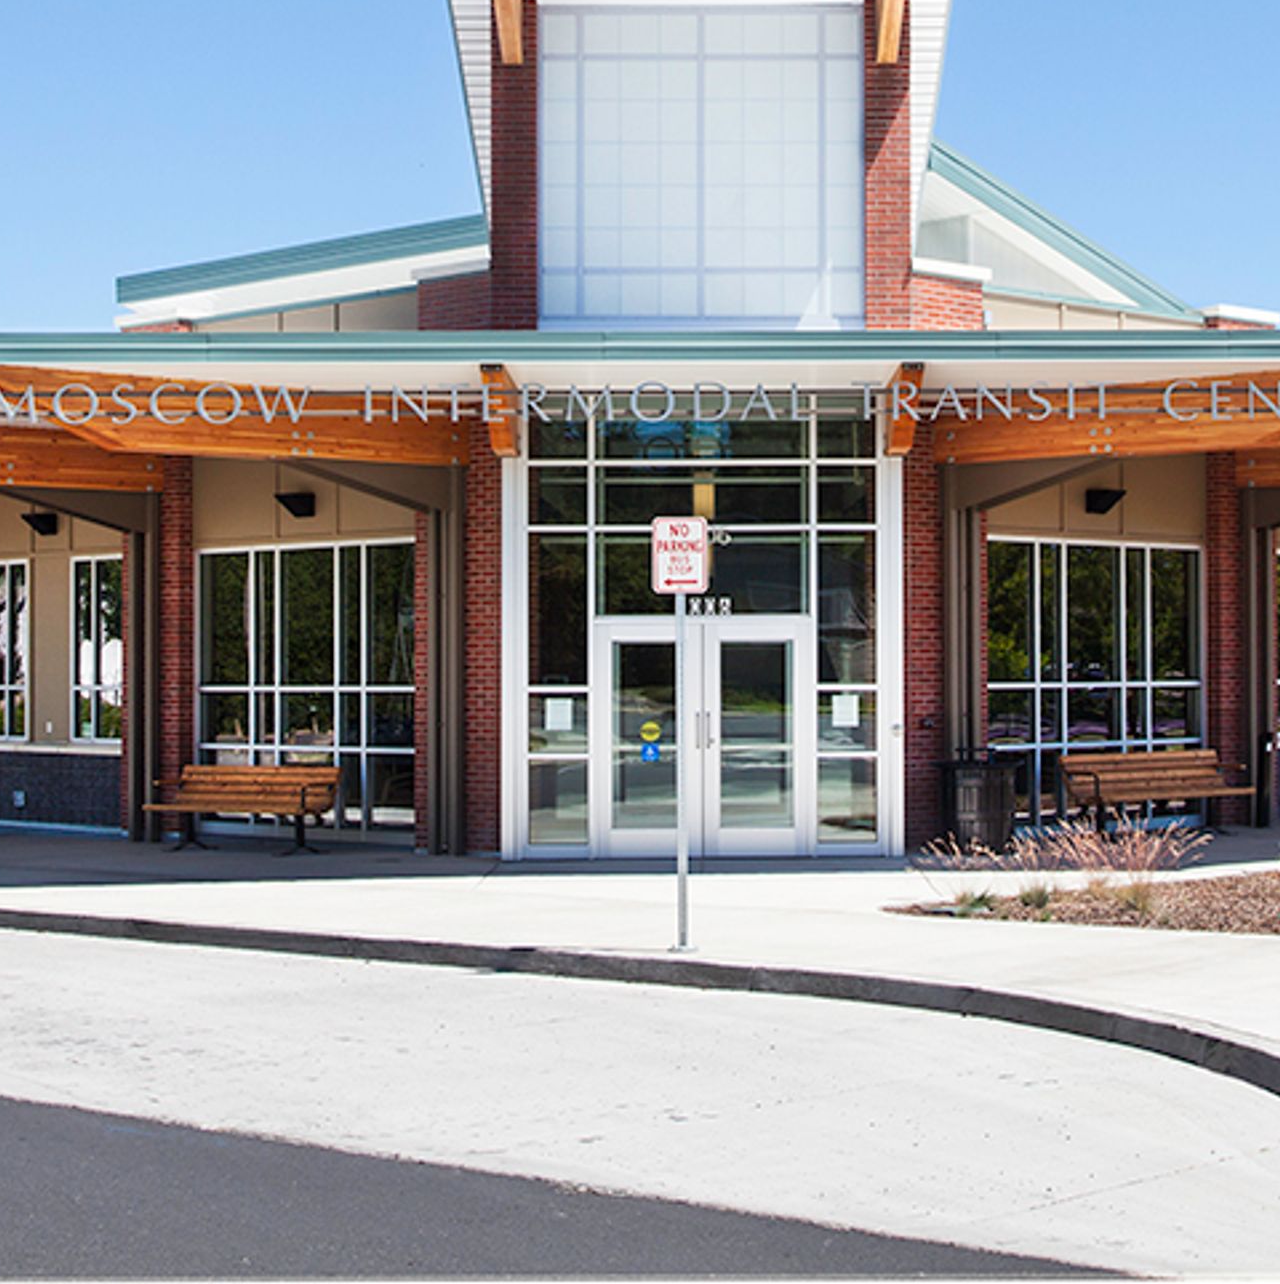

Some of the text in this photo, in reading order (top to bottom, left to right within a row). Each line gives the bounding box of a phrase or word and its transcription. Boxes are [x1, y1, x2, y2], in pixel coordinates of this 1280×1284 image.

[362, 381, 812, 424] INTERMODAL
[851, 380, 1119, 421] TRANSIT
[669, 523, 690, 538] NO
[656, 539, 705, 553] PARKING
